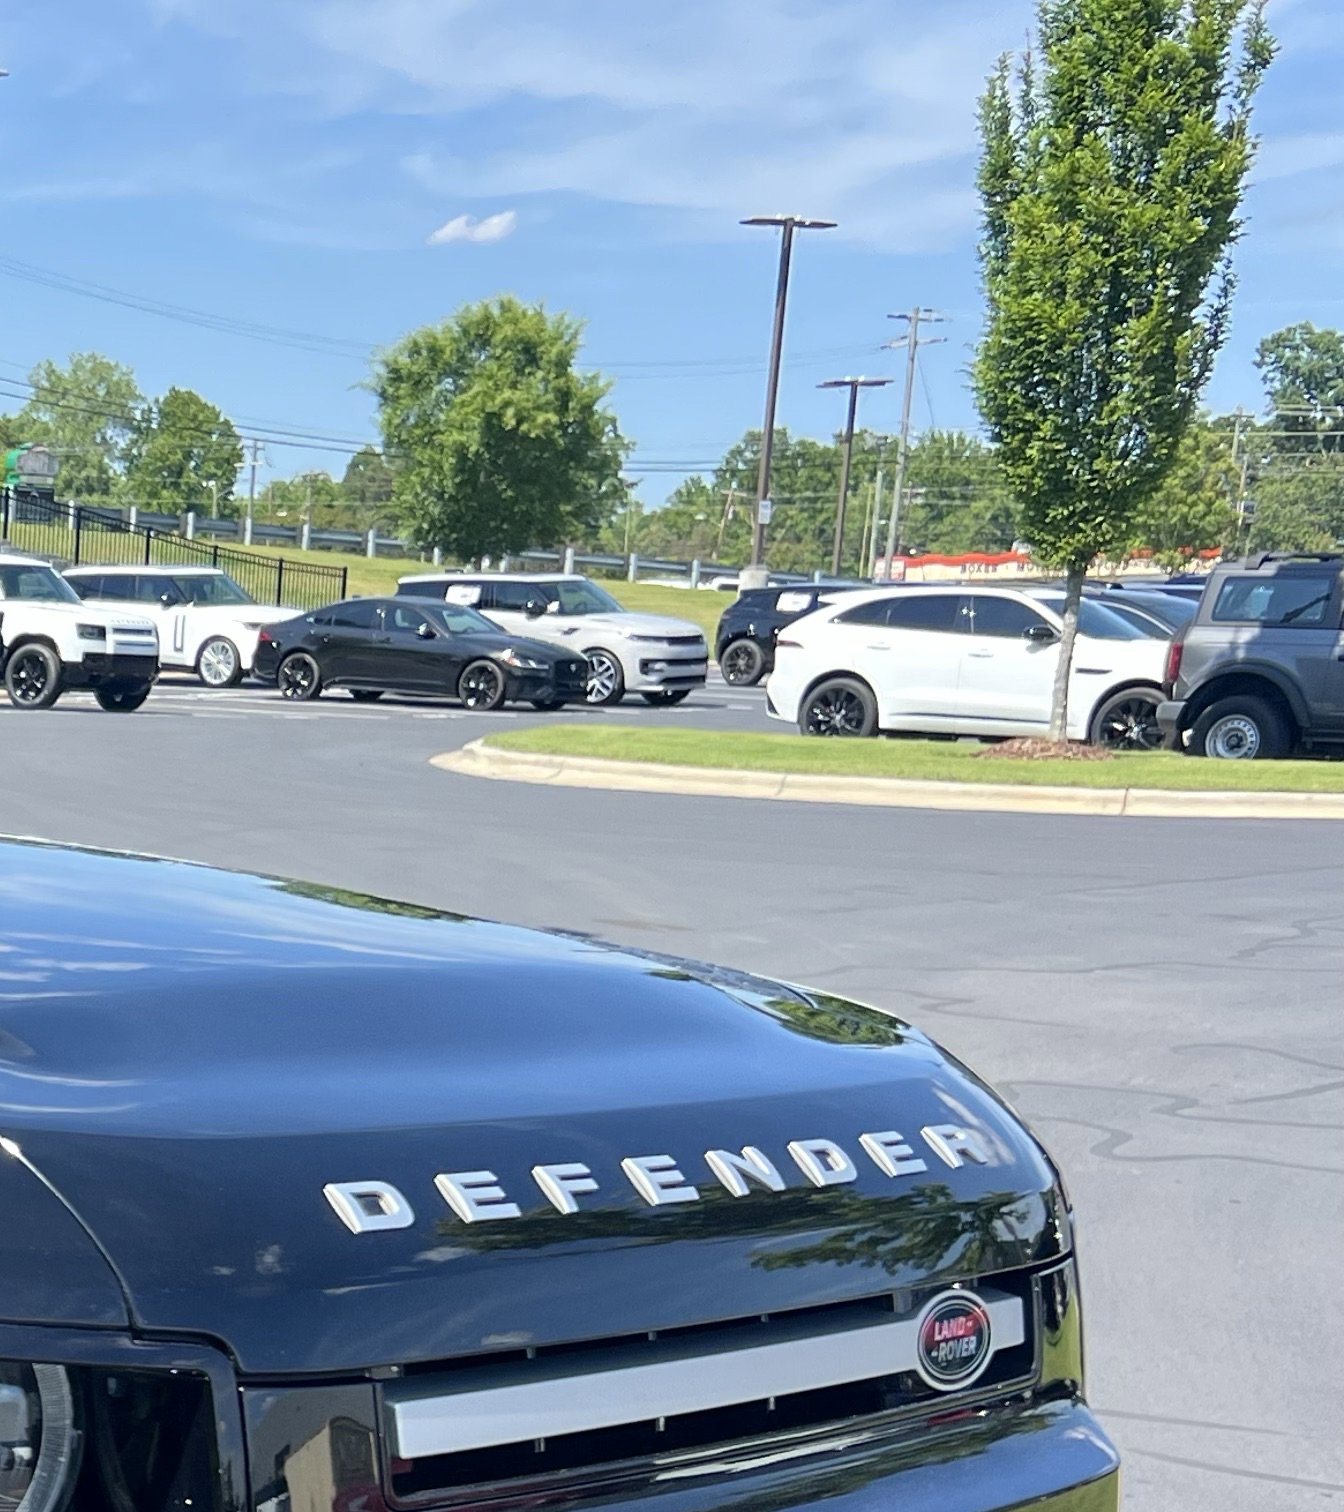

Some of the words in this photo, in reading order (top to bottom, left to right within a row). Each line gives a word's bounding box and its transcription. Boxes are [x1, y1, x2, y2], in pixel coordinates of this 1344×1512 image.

[323, 1123, 992, 1235] DEFENDER
[934, 1315, 966, 1341] LAND
[937, 1336, 977, 1361] ROVER
